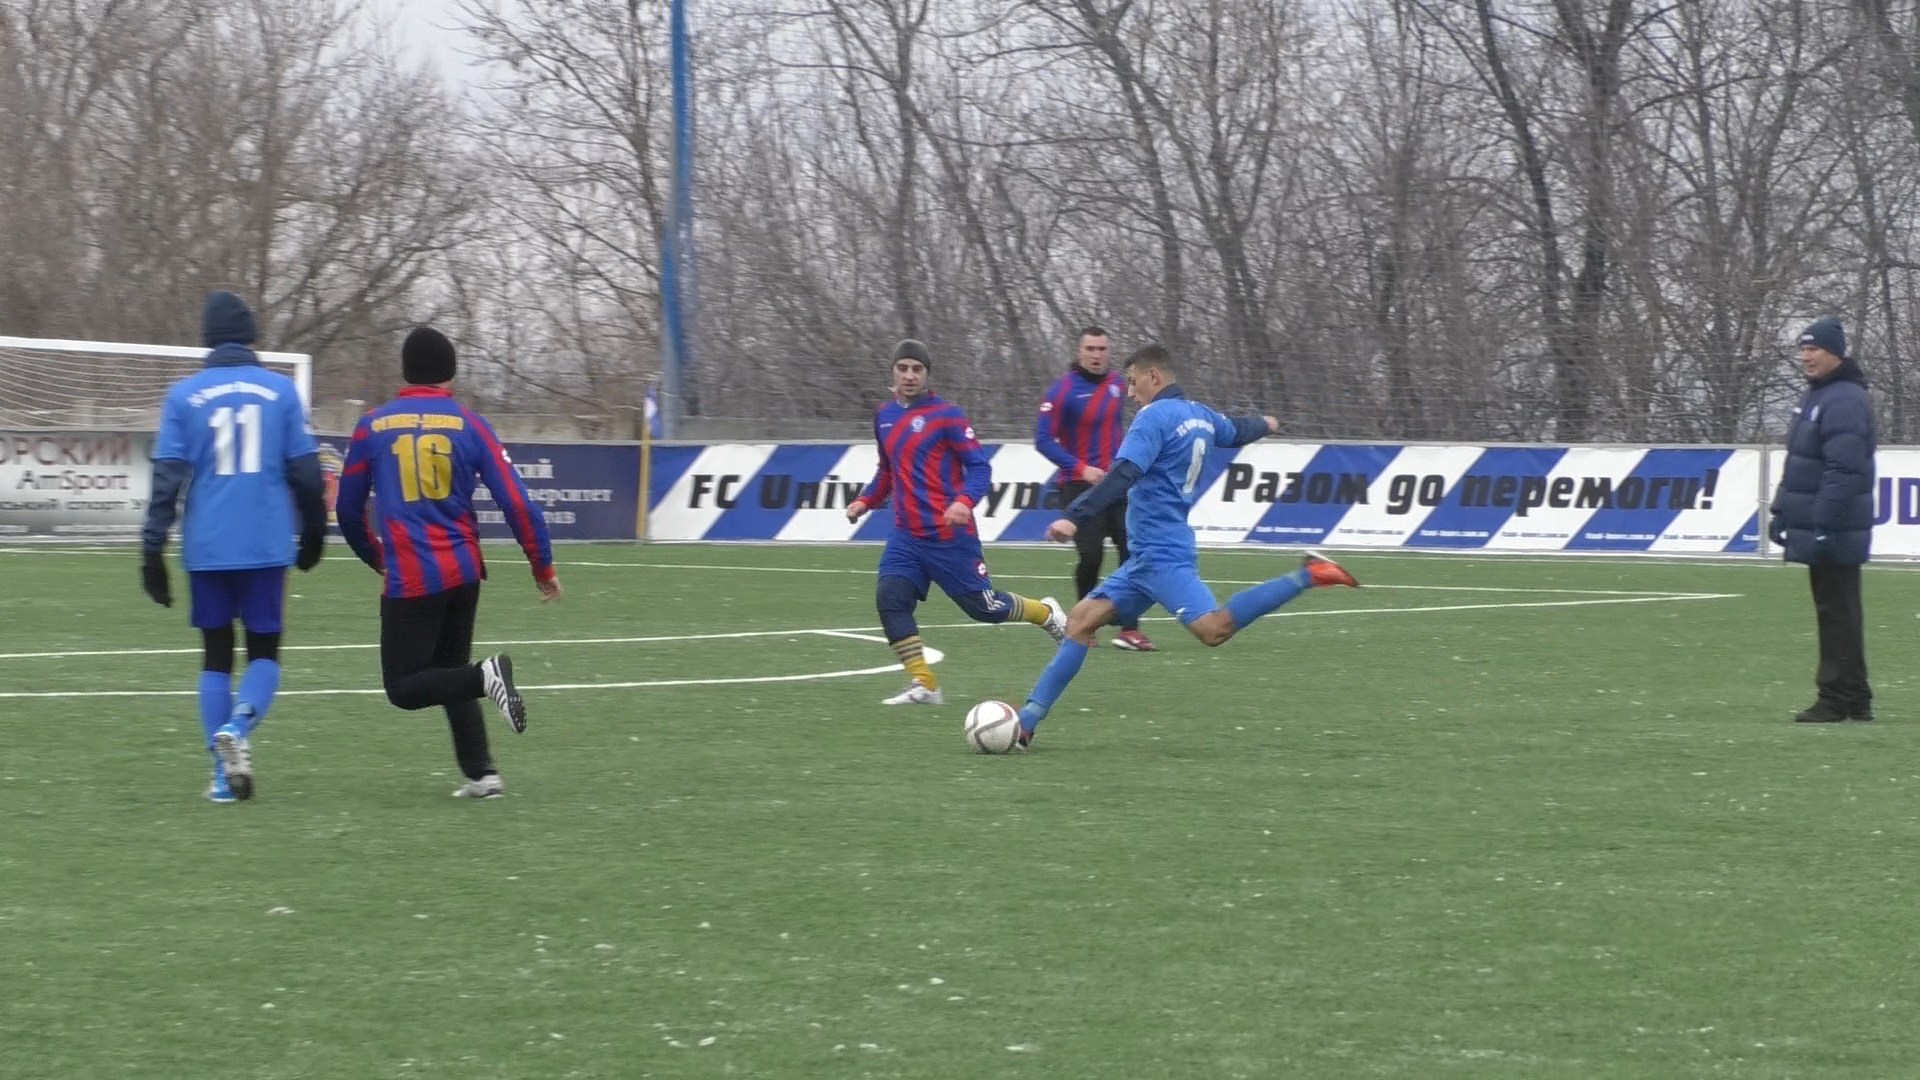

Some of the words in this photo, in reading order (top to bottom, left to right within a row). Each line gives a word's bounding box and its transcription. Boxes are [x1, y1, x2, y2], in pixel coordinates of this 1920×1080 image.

[208, 403, 262, 475] 11
[16, 470, 130, 495] AmSport
[391, 433, 453, 502] 16
[1221, 463, 1370, 505] Разом
[688, 474, 742, 509] FC
